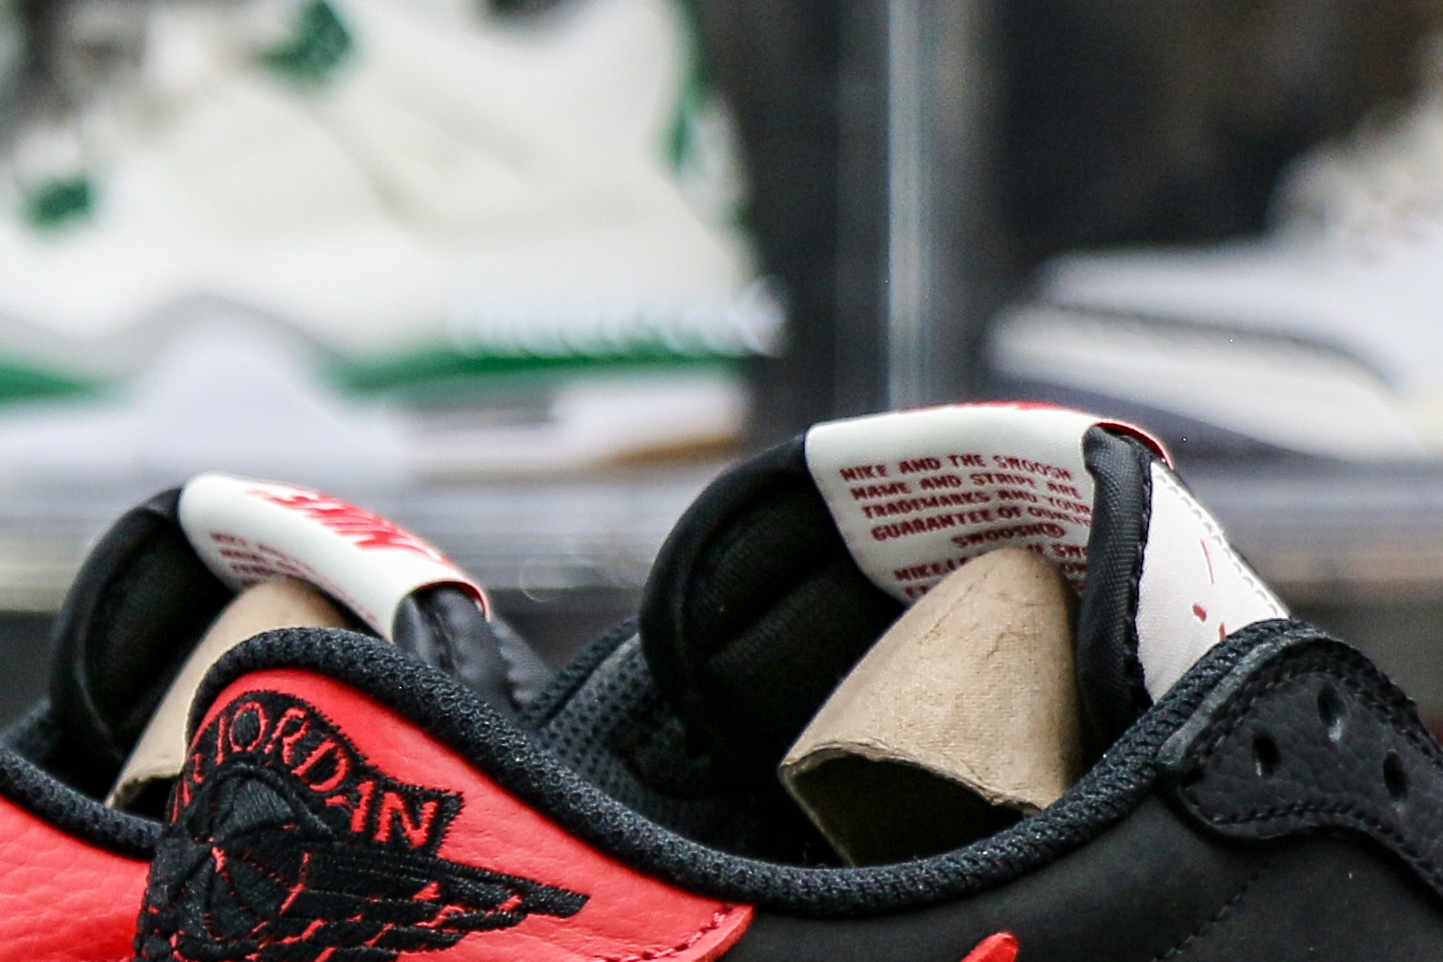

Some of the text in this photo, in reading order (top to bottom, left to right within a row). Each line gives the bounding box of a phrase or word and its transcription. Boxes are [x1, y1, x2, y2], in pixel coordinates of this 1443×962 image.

[839, 454, 1072, 482] NIKE AND THE SWOOSH
[850, 482, 911, 501] NAME
[920, 475, 962, 490] AND
[1047, 481, 1082, 499] ARE
[861, 491, 990, 519] TRADEMARKS
[997, 489, 1038, 503] AND
[871, 508, 995, 542] GUARANTEE
[997, 506, 1022, 519] OF
[214, 700, 440, 849] JORDAN
